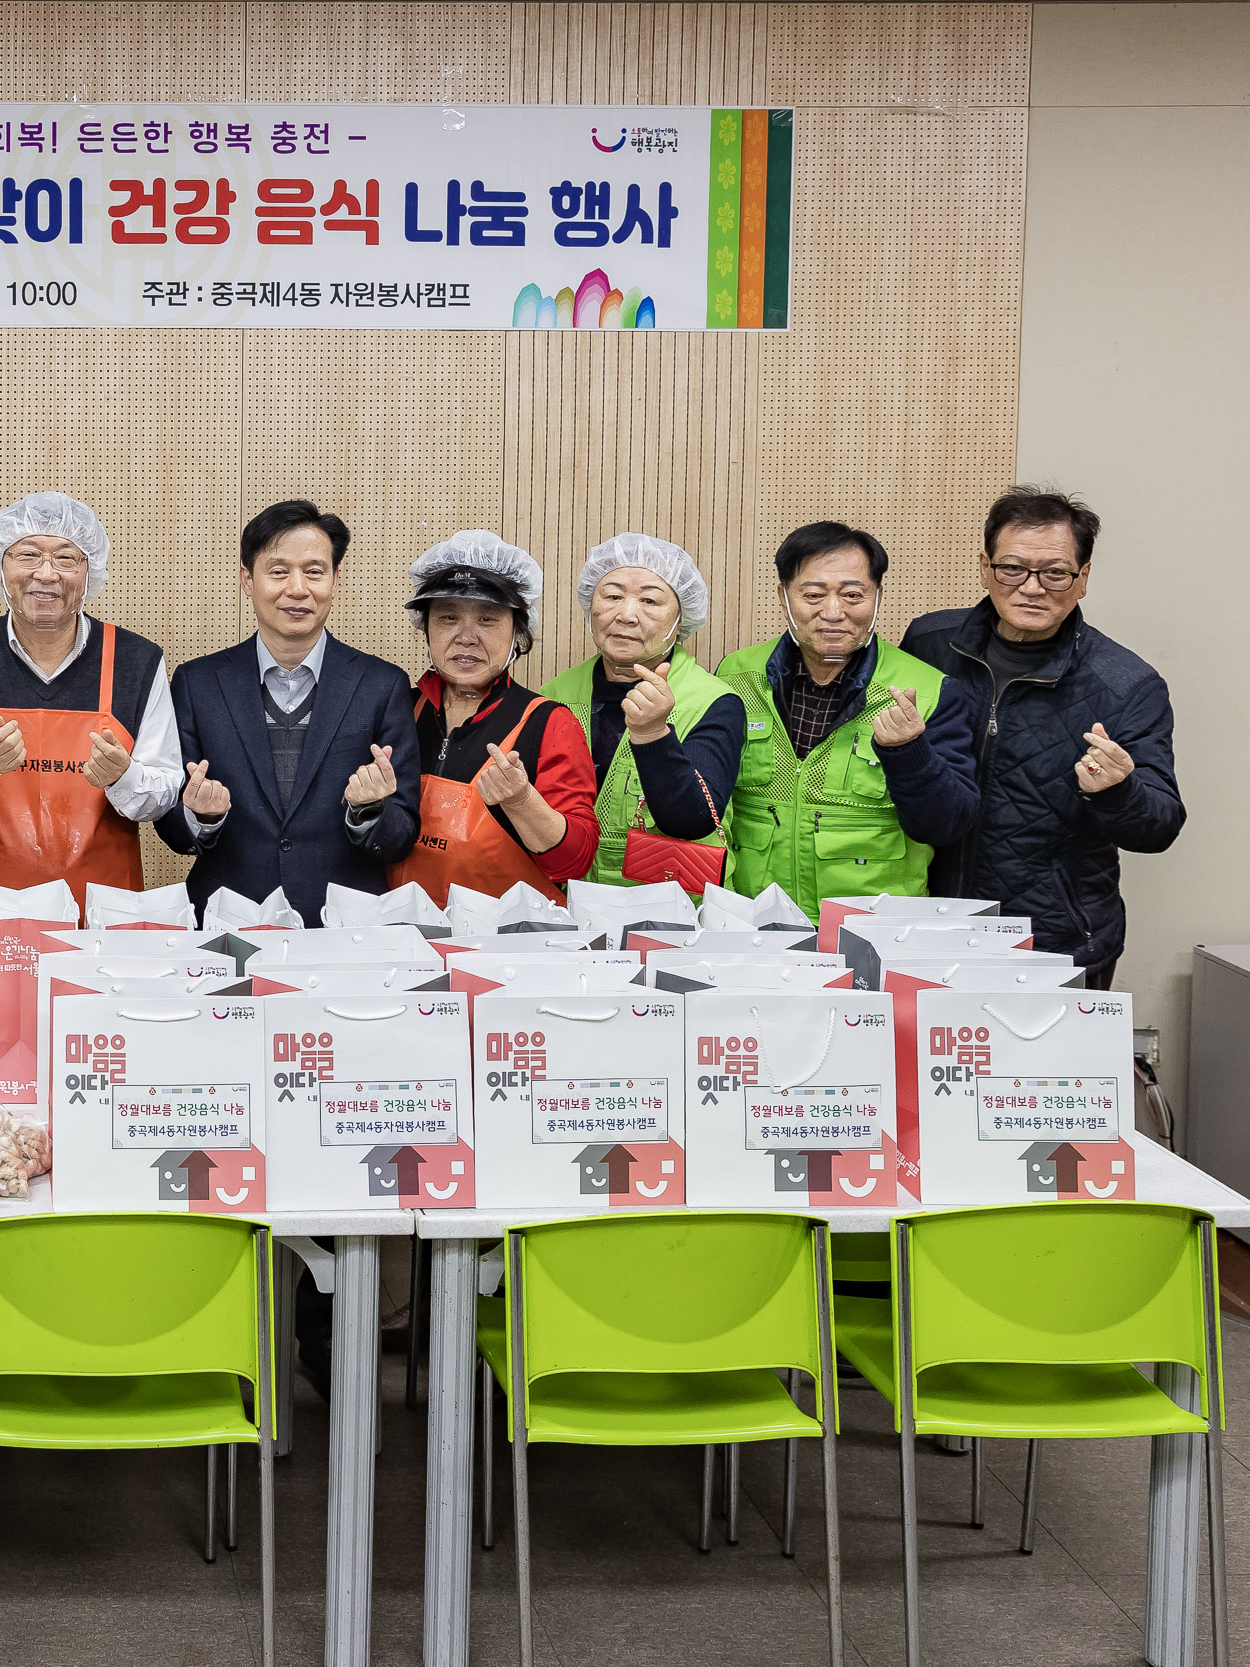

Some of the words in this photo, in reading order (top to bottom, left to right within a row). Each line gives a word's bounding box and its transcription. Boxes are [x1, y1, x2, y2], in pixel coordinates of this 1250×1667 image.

[77, 121, 172, 153] 든든한
[189, 121, 252, 153] 행복
[271, 121, 329, 154] 충전
[630, 137, 678, 153] 행복광진
[107, 178, 237, 245] 건강
[255, 179, 380, 246] 음식
[405, 180, 529, 247] 나눔
[549, 180, 679, 249] 행사
[6, 281, 78, 307] 10:00
[142, 281, 190, 307] 주관
[211, 281, 322, 307] 중곡제4동
[330, 281, 471, 308] 자원봉사캠프
[414, 834, 448, 851] 사센터
[65, 1034, 126, 1083] 마음을
[274, 1032, 334, 1080] 마음을
[486, 1031, 546, 1079] 마음을
[697, 1036, 758, 1084] 마음을
[930, 1026, 991, 1075] 마음을
[65, 1074, 109, 1105] 잇다
[274, 1072, 317, 1103] 잇다
[486, 1072, 530, 1101] 잇다
[697, 1075, 741, 1106] 잇다
[930, 1066, 974, 1096] 잇다
[117, 1103, 173, 1117] 정월대보름
[177, 1103, 220, 1117] 건강음식
[223, 1102, 245, 1116] 나눔
[325, 1100, 380, 1114] 정월대보름
[384, 1099, 427, 1113] 건강음식
[430, 1098, 452, 1112] 나눔
[537, 1097, 591, 1111] 정월대보름
[595, 1097, 638, 1111] 건강음식
[641, 1096, 663, 1109] 나눔
[750, 1105, 806, 1119] 정월대보름
[809, 1104, 853, 1118] 건강음식
[856, 1103, 878, 1117] 나눔
[982, 1096, 1038, 1109] 정월대보름
[1042, 1096, 1086, 1109] 건강음식
[1090, 1095, 1113, 1109] 나눔
[127, 1125, 239, 1138] 중곡제4동자원봉사캠프
[335, 1120, 447, 1134] 중곡제4동자원봉사캠프
[547, 1117, 657, 1132] 중곡제4동자원봉사캠프
[760, 1125, 872, 1139] 중곡제4동자원봉사캠프
[993, 1117, 1107, 1130] 중곡제4동자원봉사캠프
